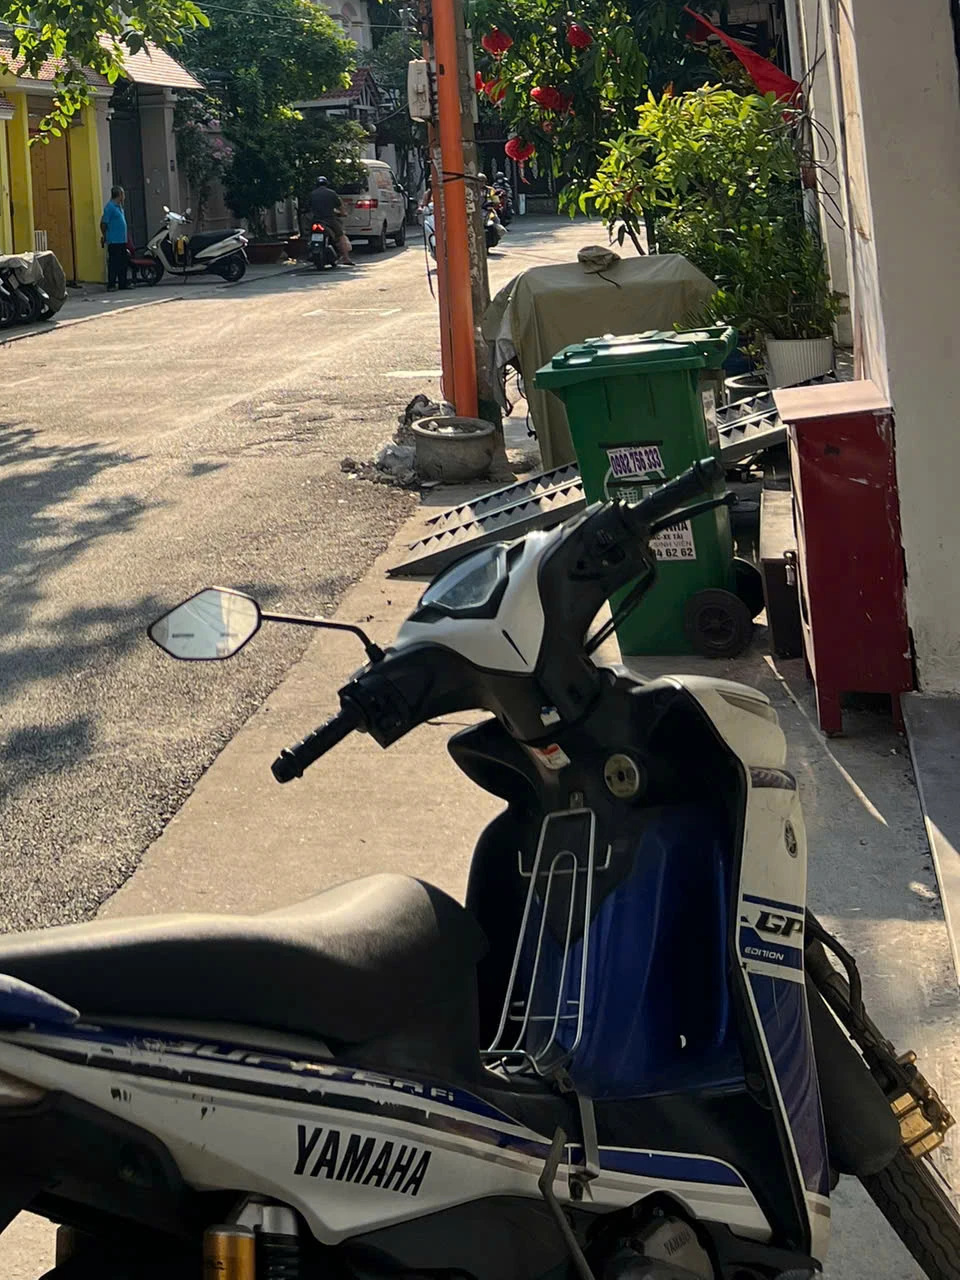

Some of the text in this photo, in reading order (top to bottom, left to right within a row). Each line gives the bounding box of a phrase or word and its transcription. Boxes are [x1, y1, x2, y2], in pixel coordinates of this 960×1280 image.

[665, 547, 679, 558] 62
[680, 547, 694, 557] 62
[754, 910, 803, 939] GP
[744, 946, 785, 961] EDITION
[292, 1124, 433, 1197] YAMAHA
